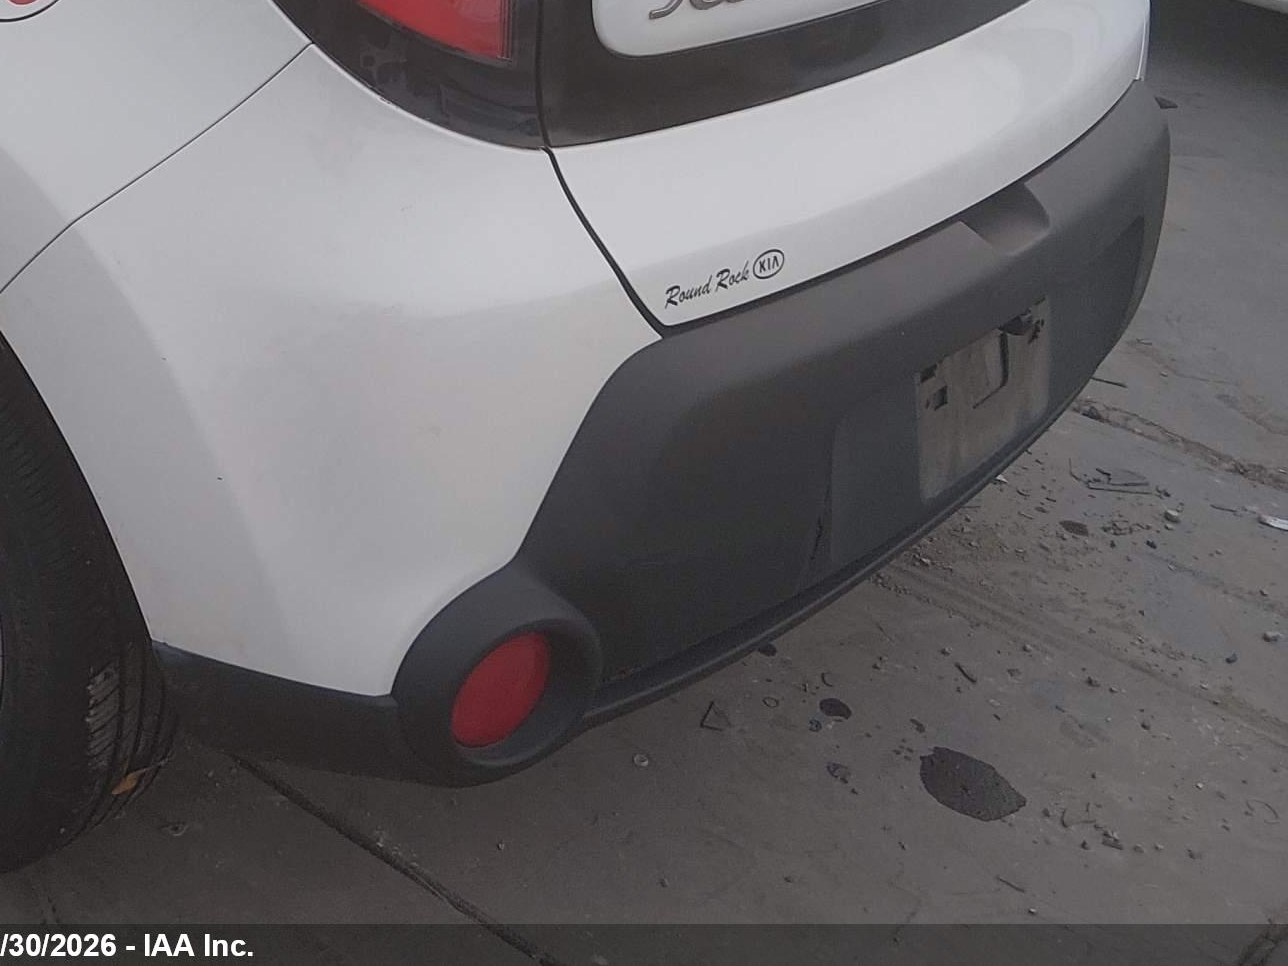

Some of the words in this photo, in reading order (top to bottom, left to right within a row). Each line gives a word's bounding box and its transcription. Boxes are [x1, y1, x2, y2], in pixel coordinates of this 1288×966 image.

[664, 274, 713, 309] Round
[715, 260, 750, 292] Rock
[758, 255, 780, 274] KIA
